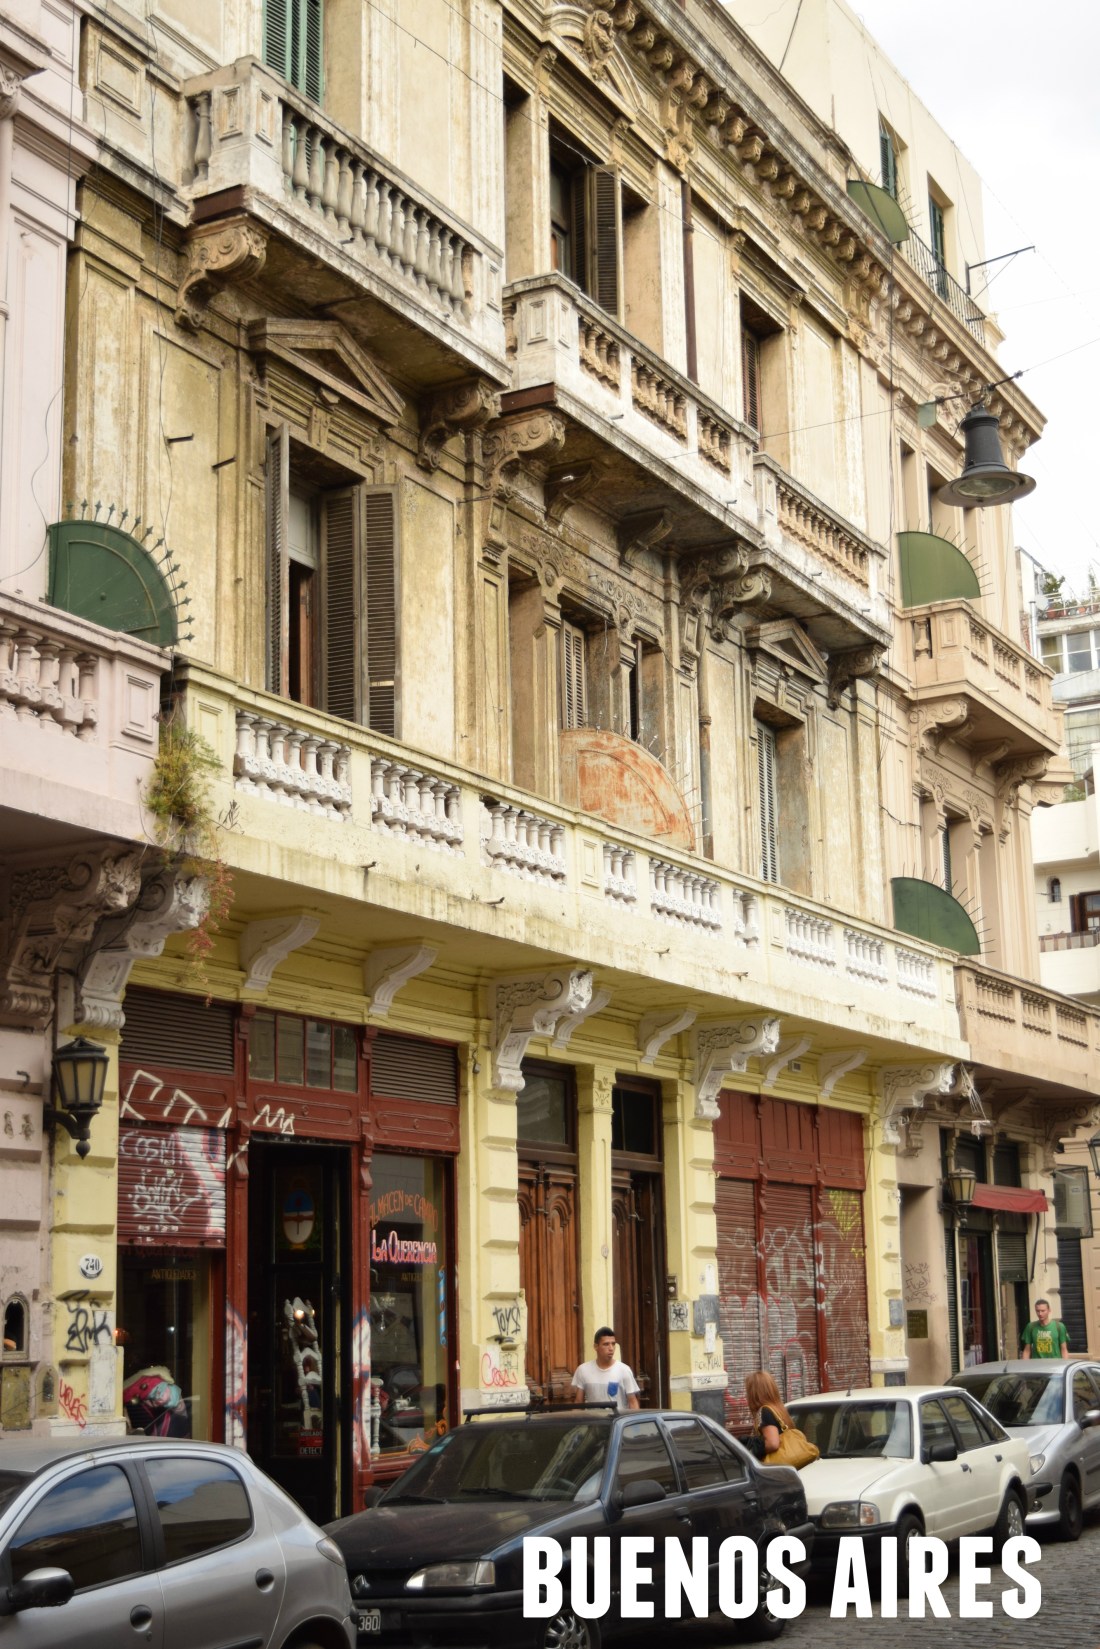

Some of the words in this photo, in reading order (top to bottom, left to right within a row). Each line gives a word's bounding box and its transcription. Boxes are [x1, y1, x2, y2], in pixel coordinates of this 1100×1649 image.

[388, 1230, 437, 1264] QUERENCIA
[84, 1258, 100, 1271] 740
[358, 1616, 379, 1631] 380
